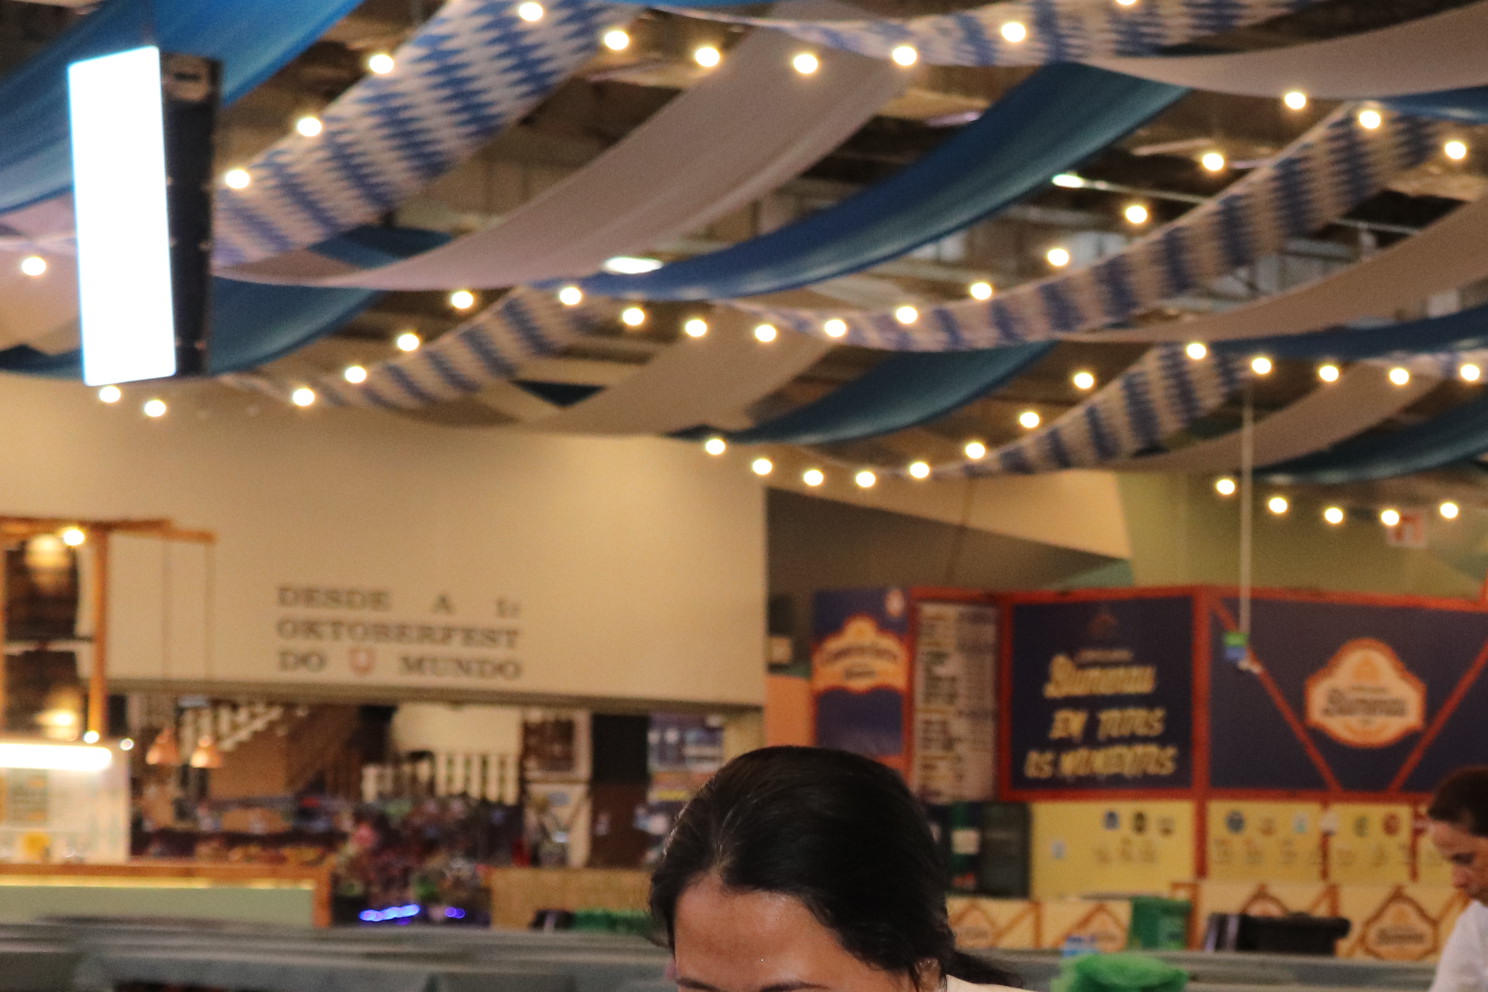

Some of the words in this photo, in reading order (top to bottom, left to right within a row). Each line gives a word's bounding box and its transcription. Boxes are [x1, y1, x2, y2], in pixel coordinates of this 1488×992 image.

[277, 586, 390, 611] DESDE
[433, 595, 454, 615] A
[276, 618, 521, 649] OKTOBERFEST
[278, 650, 328, 673] DO
[398, 655, 522, 680] MUNDO
